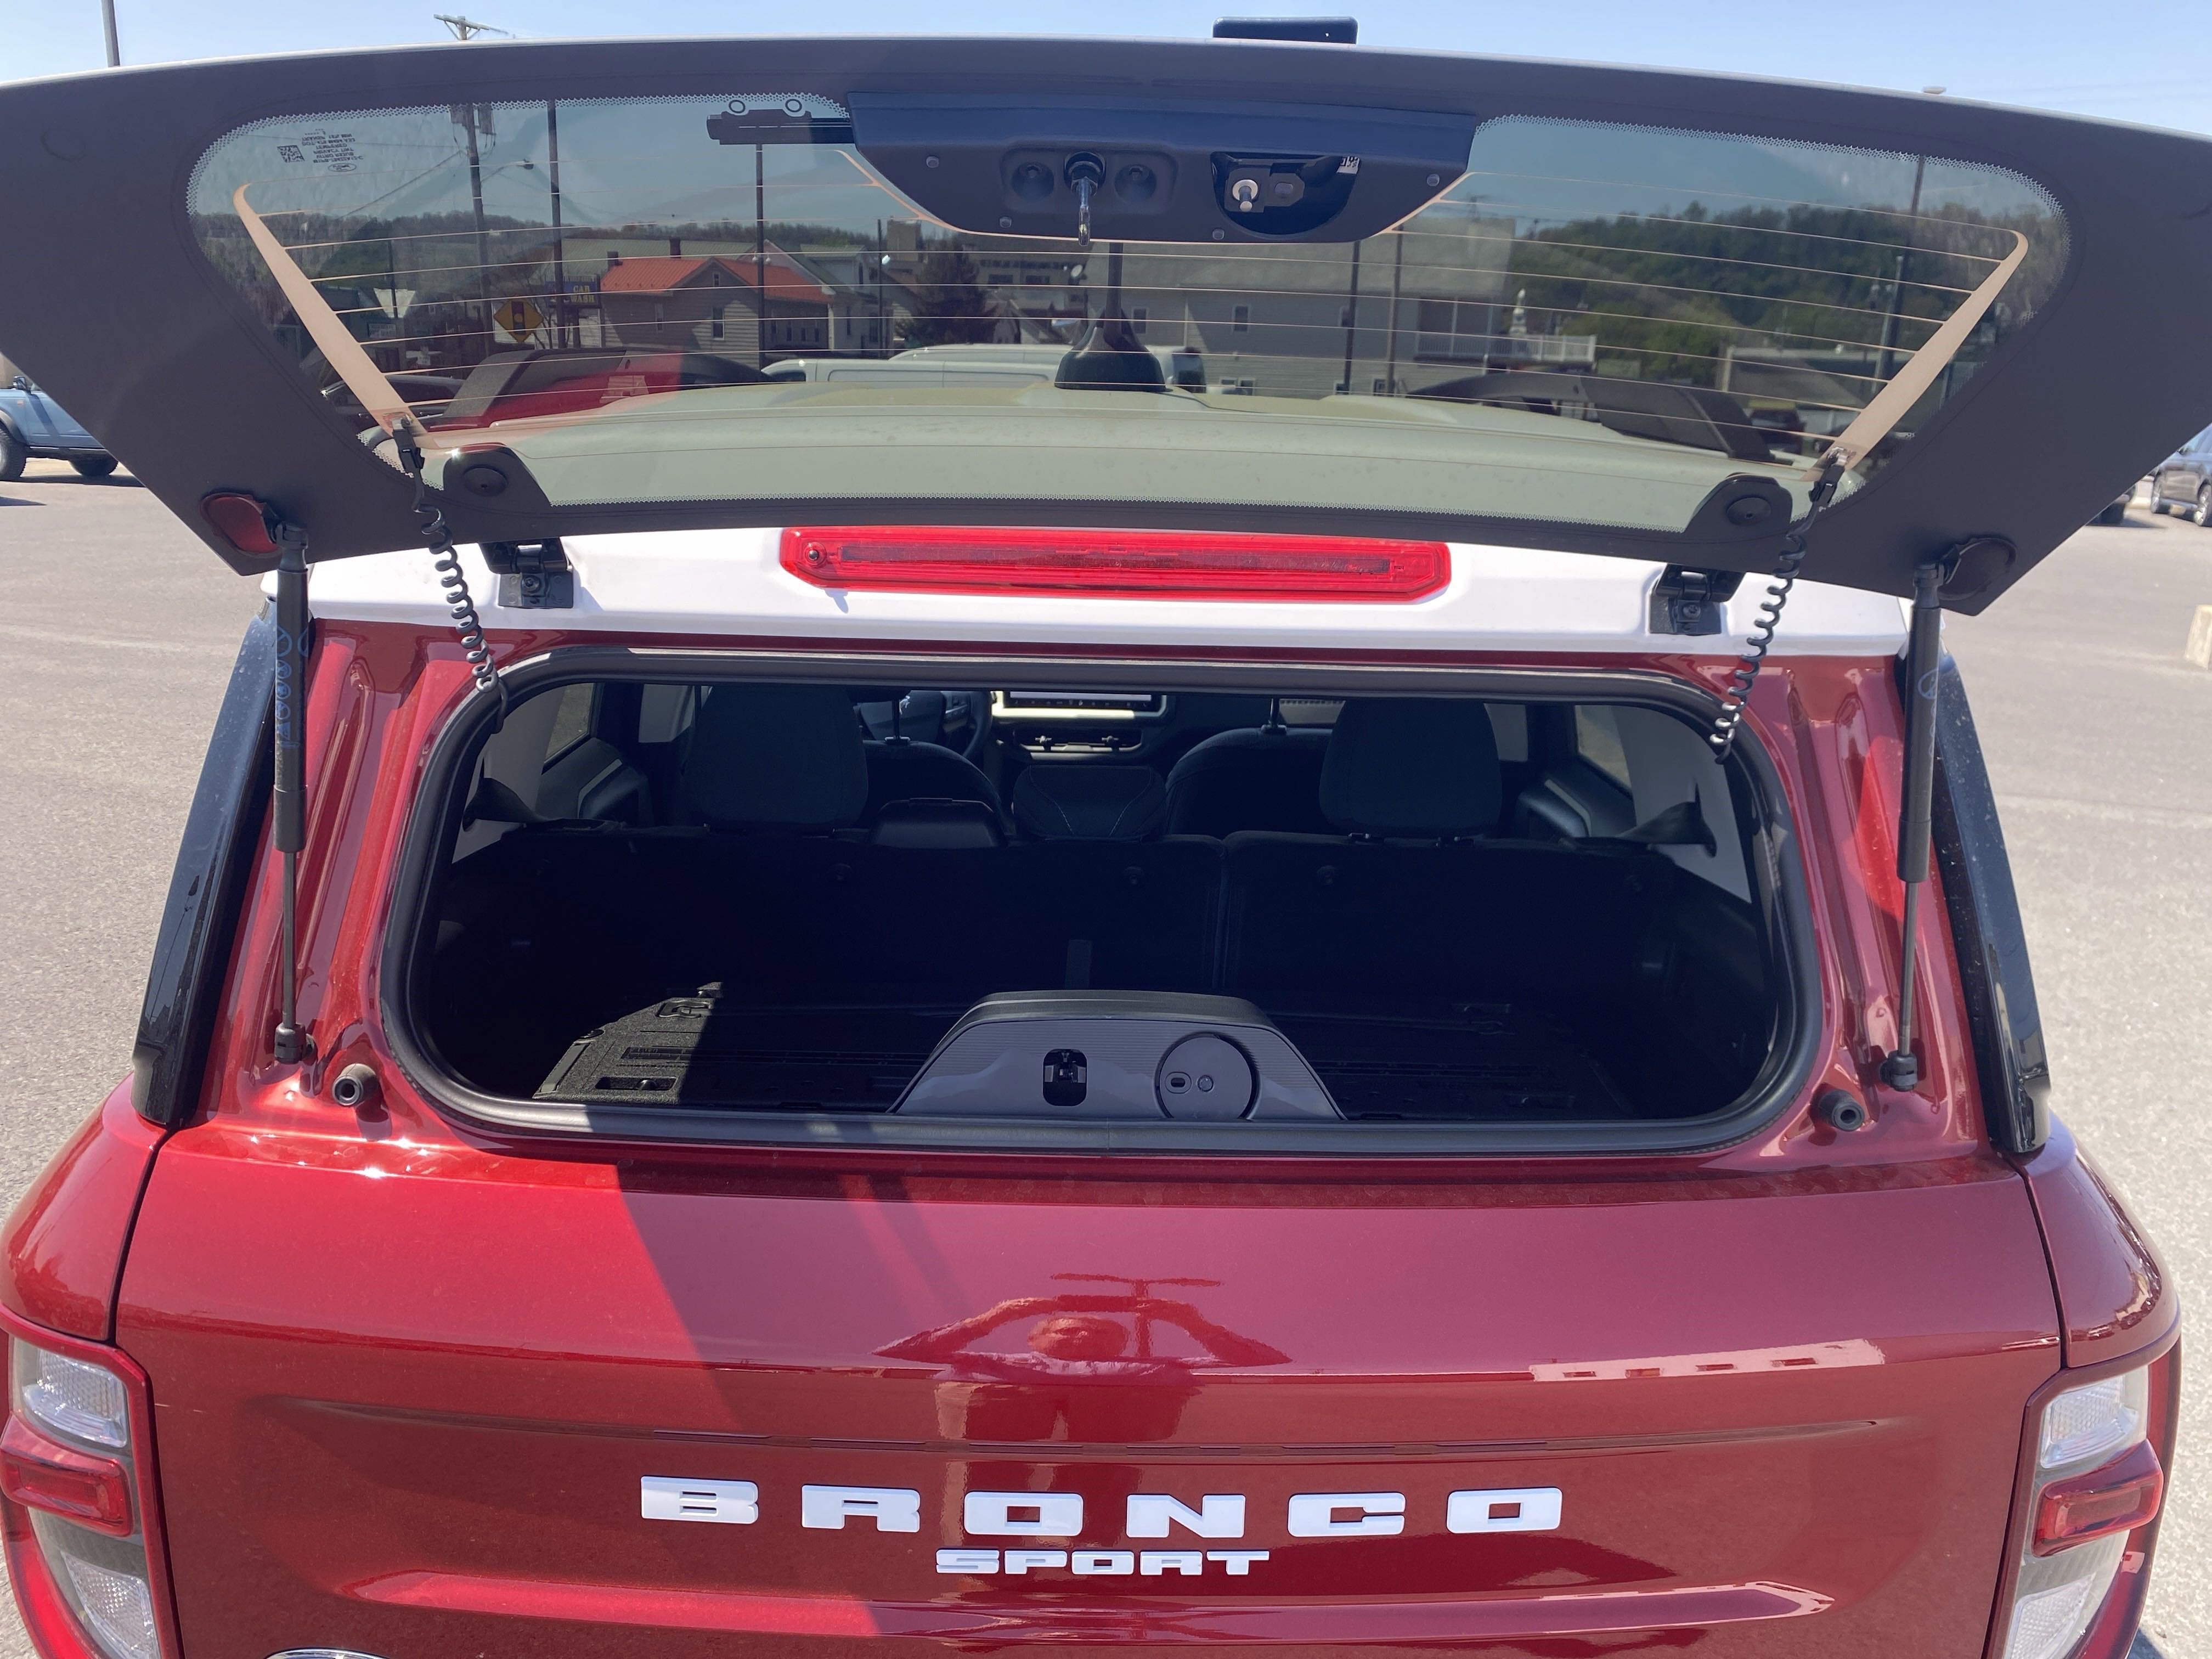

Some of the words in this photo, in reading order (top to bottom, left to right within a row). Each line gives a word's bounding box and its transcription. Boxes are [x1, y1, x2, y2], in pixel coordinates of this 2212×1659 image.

[571, 294, 595, 303] WASH
[573, 285, 590, 295] CAR
[640, 1475, 1562, 1538] BRONCO
[936, 1549, 1269, 1576] SPORT
